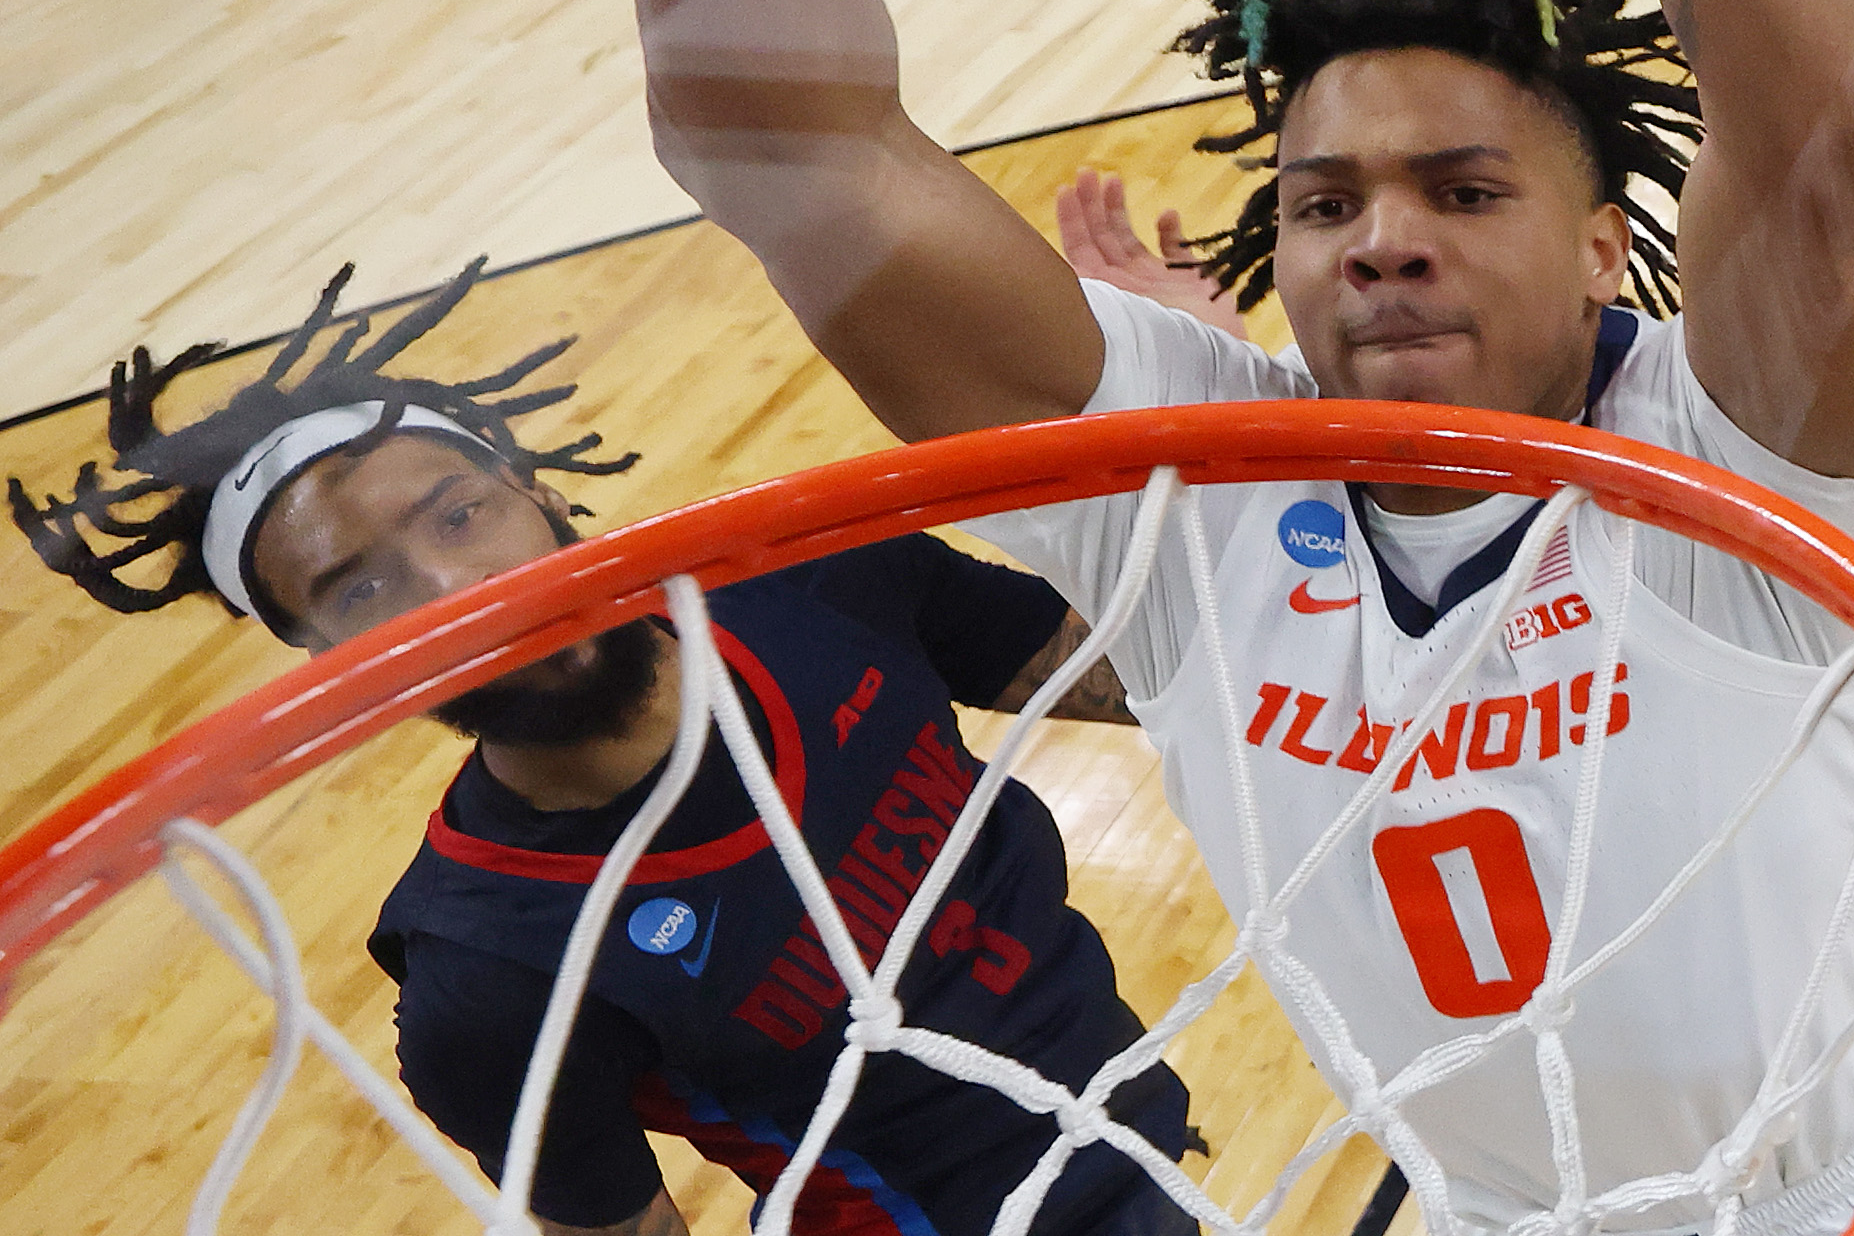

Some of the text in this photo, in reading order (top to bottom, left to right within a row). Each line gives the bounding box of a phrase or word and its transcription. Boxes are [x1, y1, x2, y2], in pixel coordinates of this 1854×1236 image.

[1287, 527, 1346, 555] NCAA
[650, 904, 690, 951] NCAA
[928, 899, 1033, 996] 3
[1372, 808, 1552, 1019] 0
